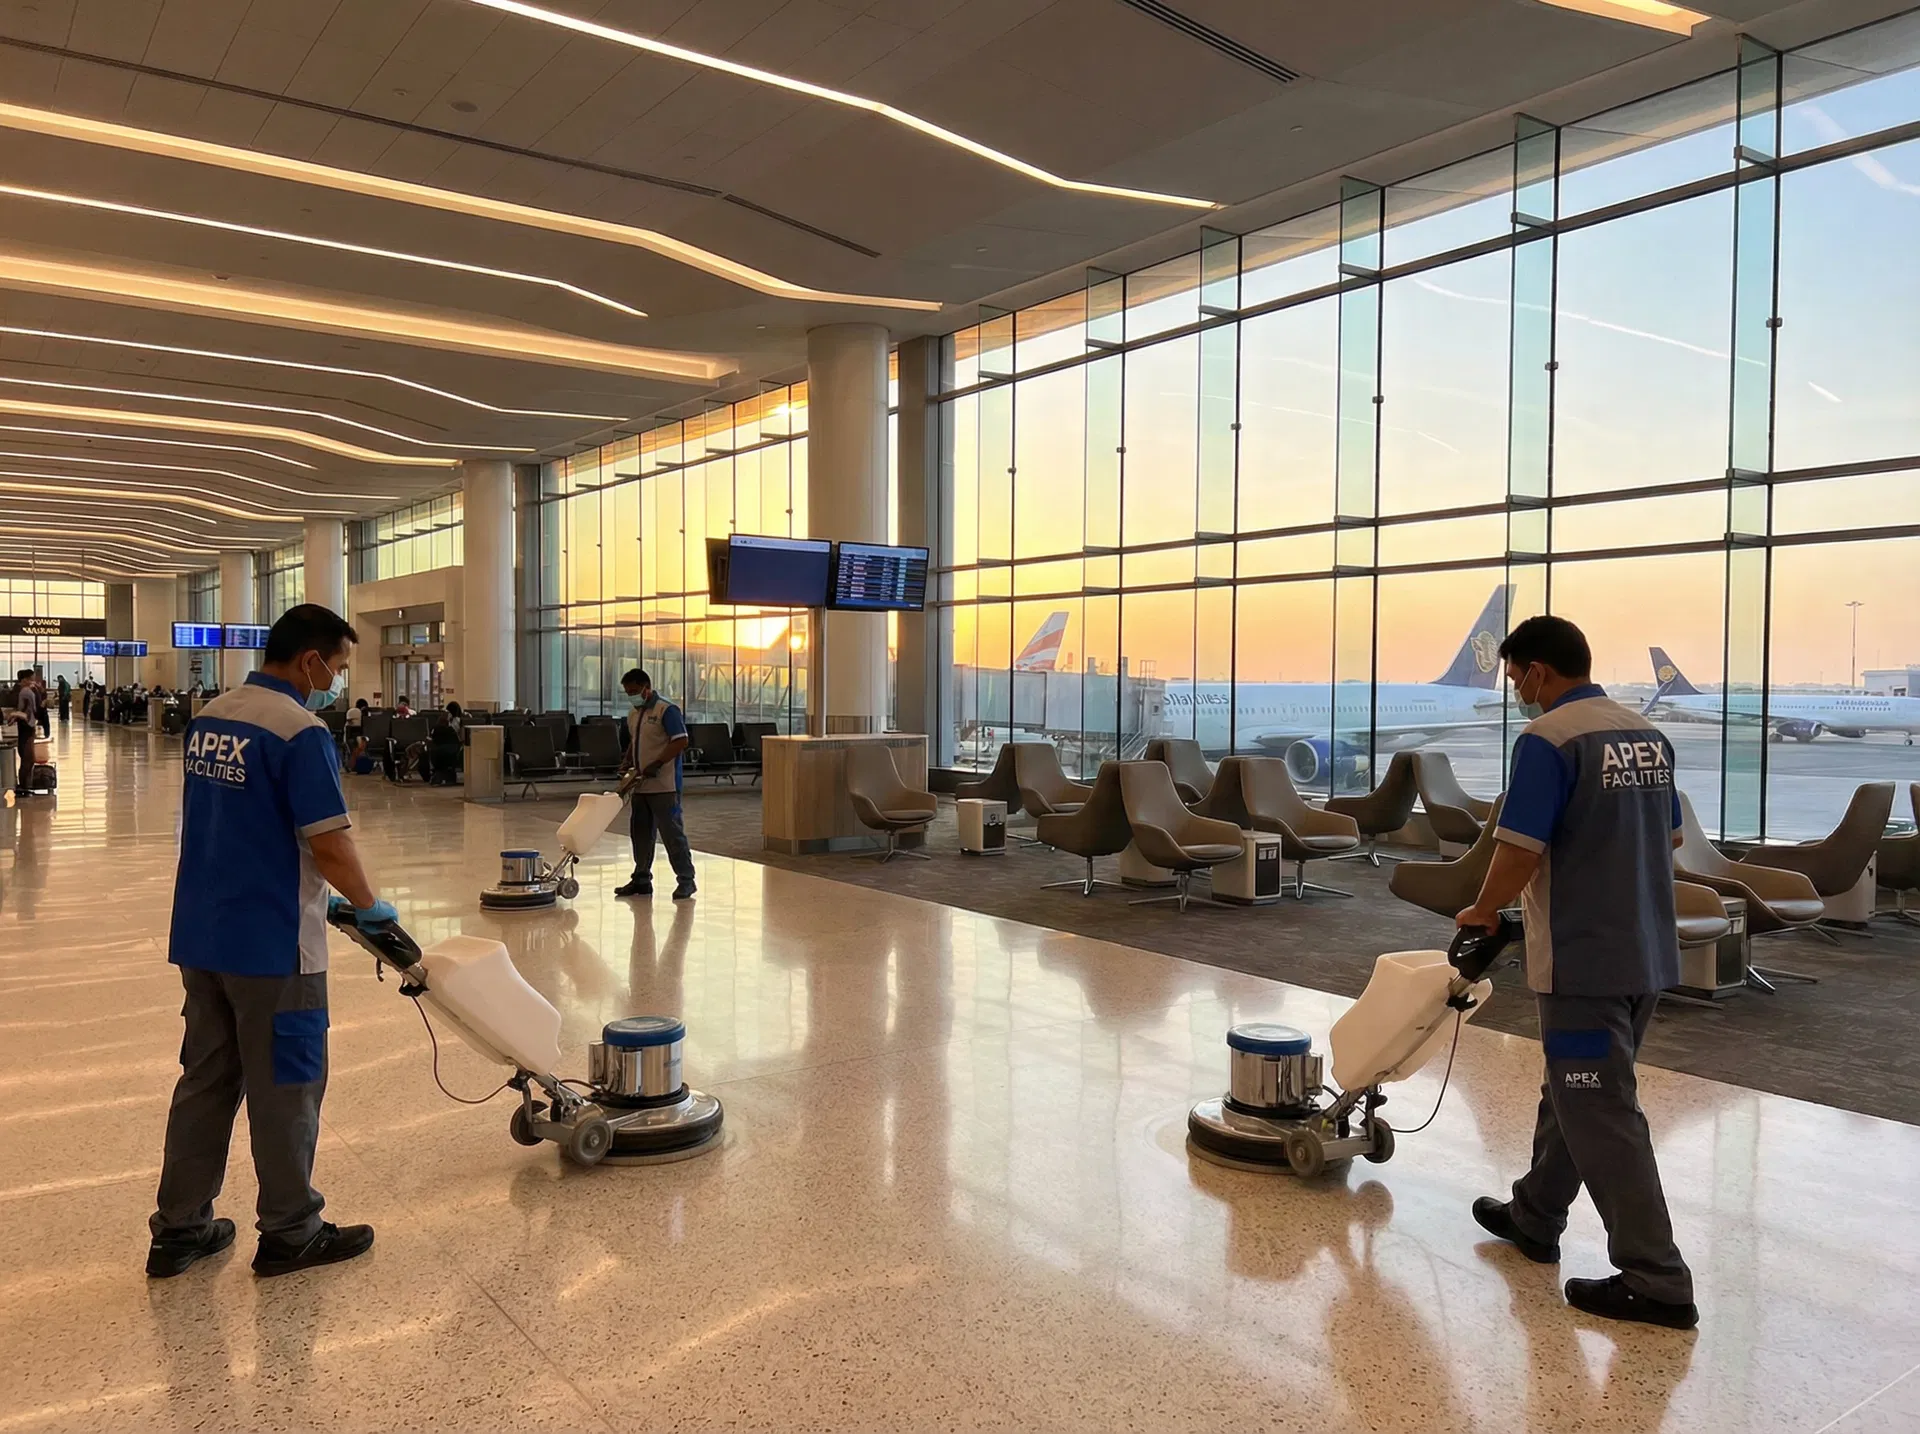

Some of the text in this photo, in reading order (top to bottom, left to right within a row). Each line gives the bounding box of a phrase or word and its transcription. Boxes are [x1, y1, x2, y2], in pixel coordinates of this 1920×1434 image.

[187, 730, 251, 766] APEX
[1602, 741, 1668, 771] APEX
[1602, 769, 1670, 789] FACILITIES
[1565, 1071, 1601, 1084] APEX
